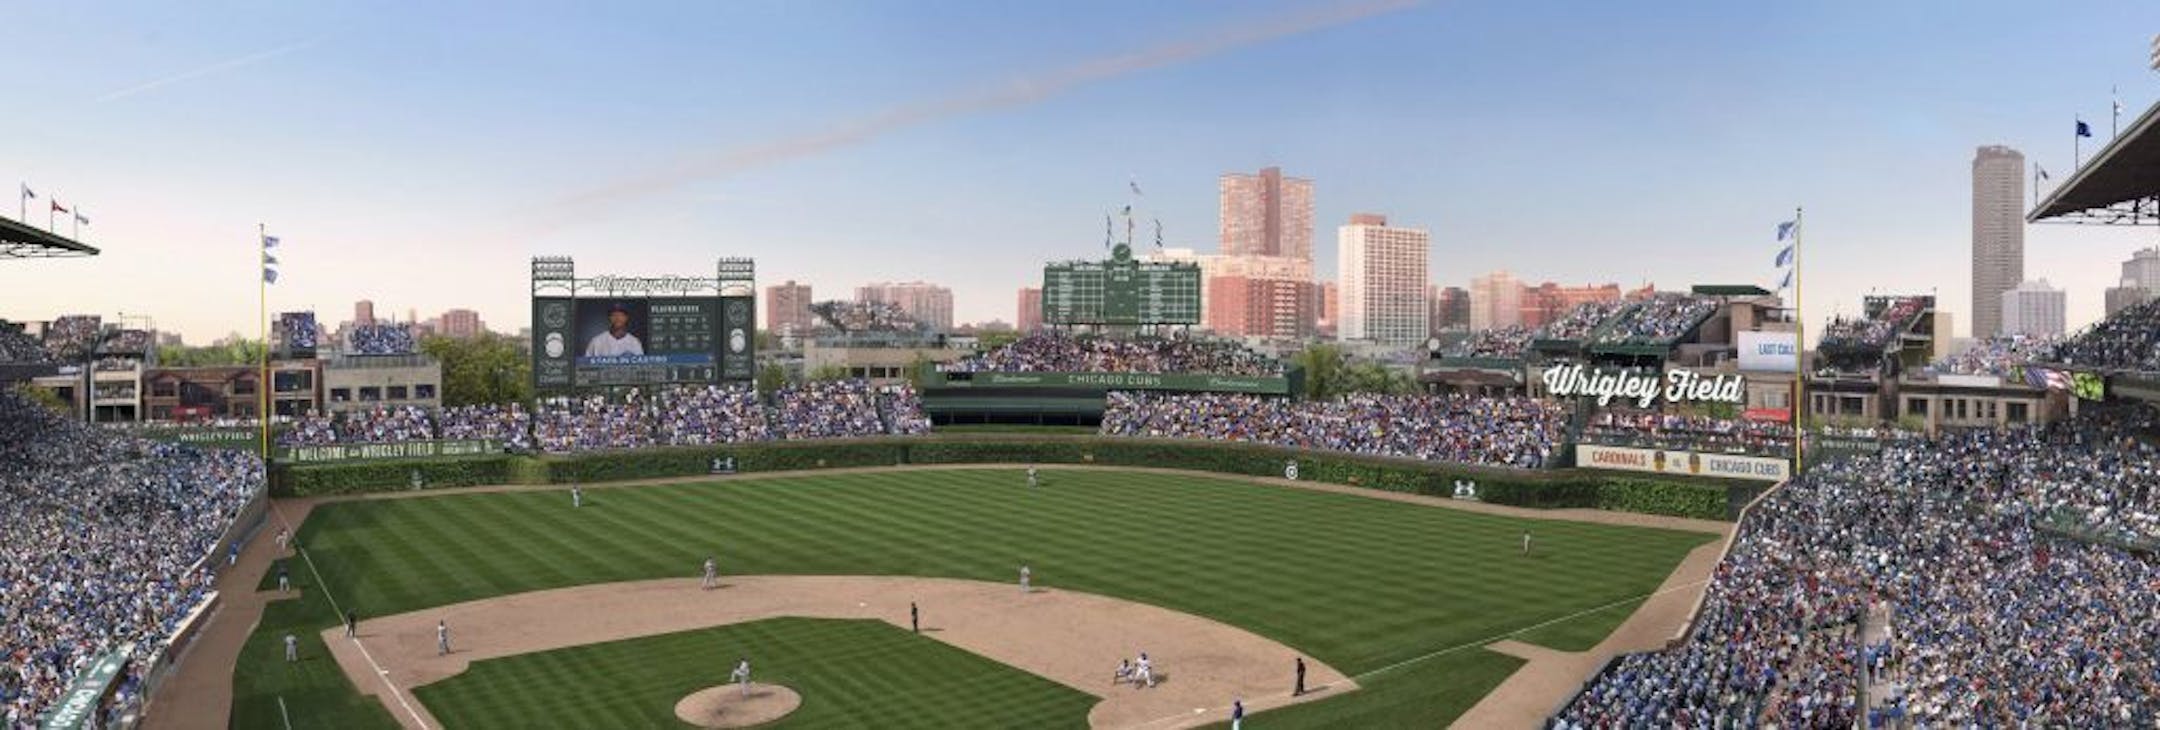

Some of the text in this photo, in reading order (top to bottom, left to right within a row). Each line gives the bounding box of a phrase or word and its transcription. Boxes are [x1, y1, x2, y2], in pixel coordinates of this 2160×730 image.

[1068, 375, 1161, 385] CHICAGO CUBS
[1544, 364, 1744, 408] Wrigley Field
[178, 432, 223, 442] WRIGLEY
[299, 447, 346, 461] WELCOME
[362, 444, 405, 458] WRIGLEY
[408, 442, 435, 456] FIELD
[1591, 449, 1782, 476] CARDINALS CHICAGO CUBS
